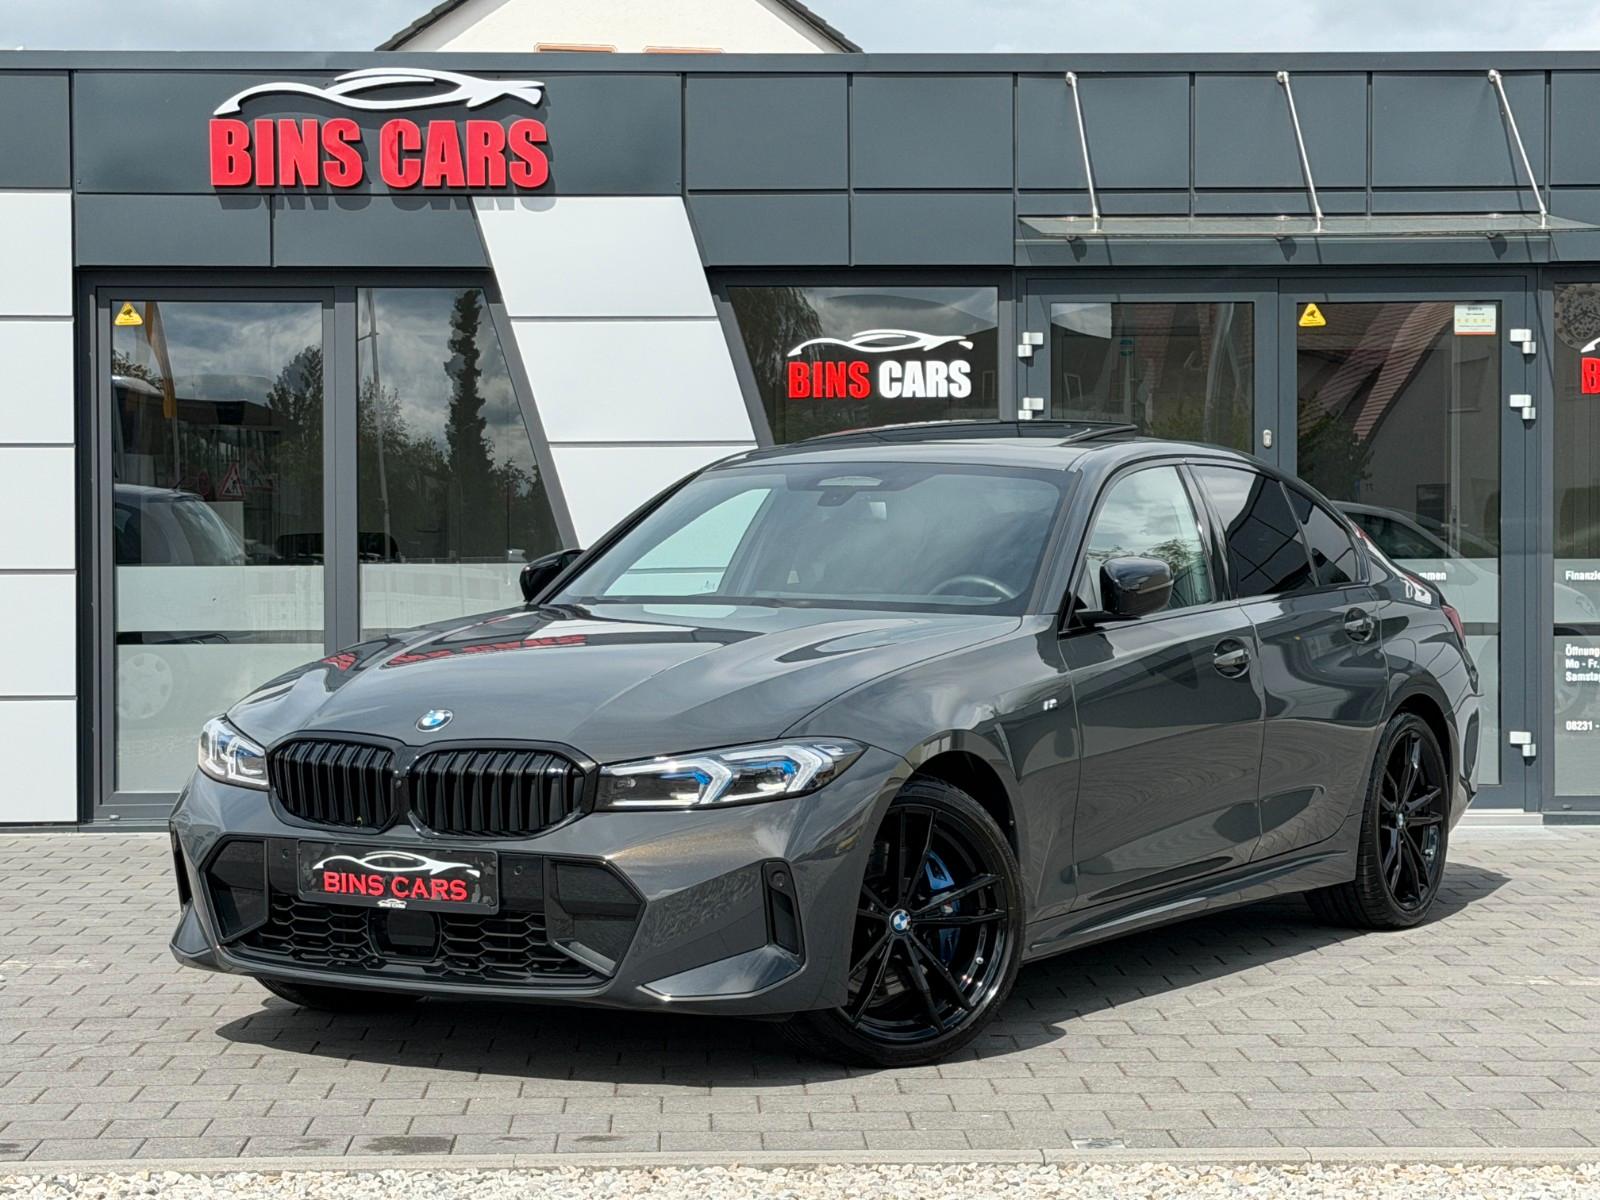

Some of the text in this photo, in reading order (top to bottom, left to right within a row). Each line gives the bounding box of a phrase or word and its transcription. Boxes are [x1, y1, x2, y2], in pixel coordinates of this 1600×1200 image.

[209, 118, 549, 188] BINS CARS
[787, 360, 972, 399] BINS CARS
[1565, 658, 1580, 669] Mo
[323, 871, 469, 901] BINS CARS
